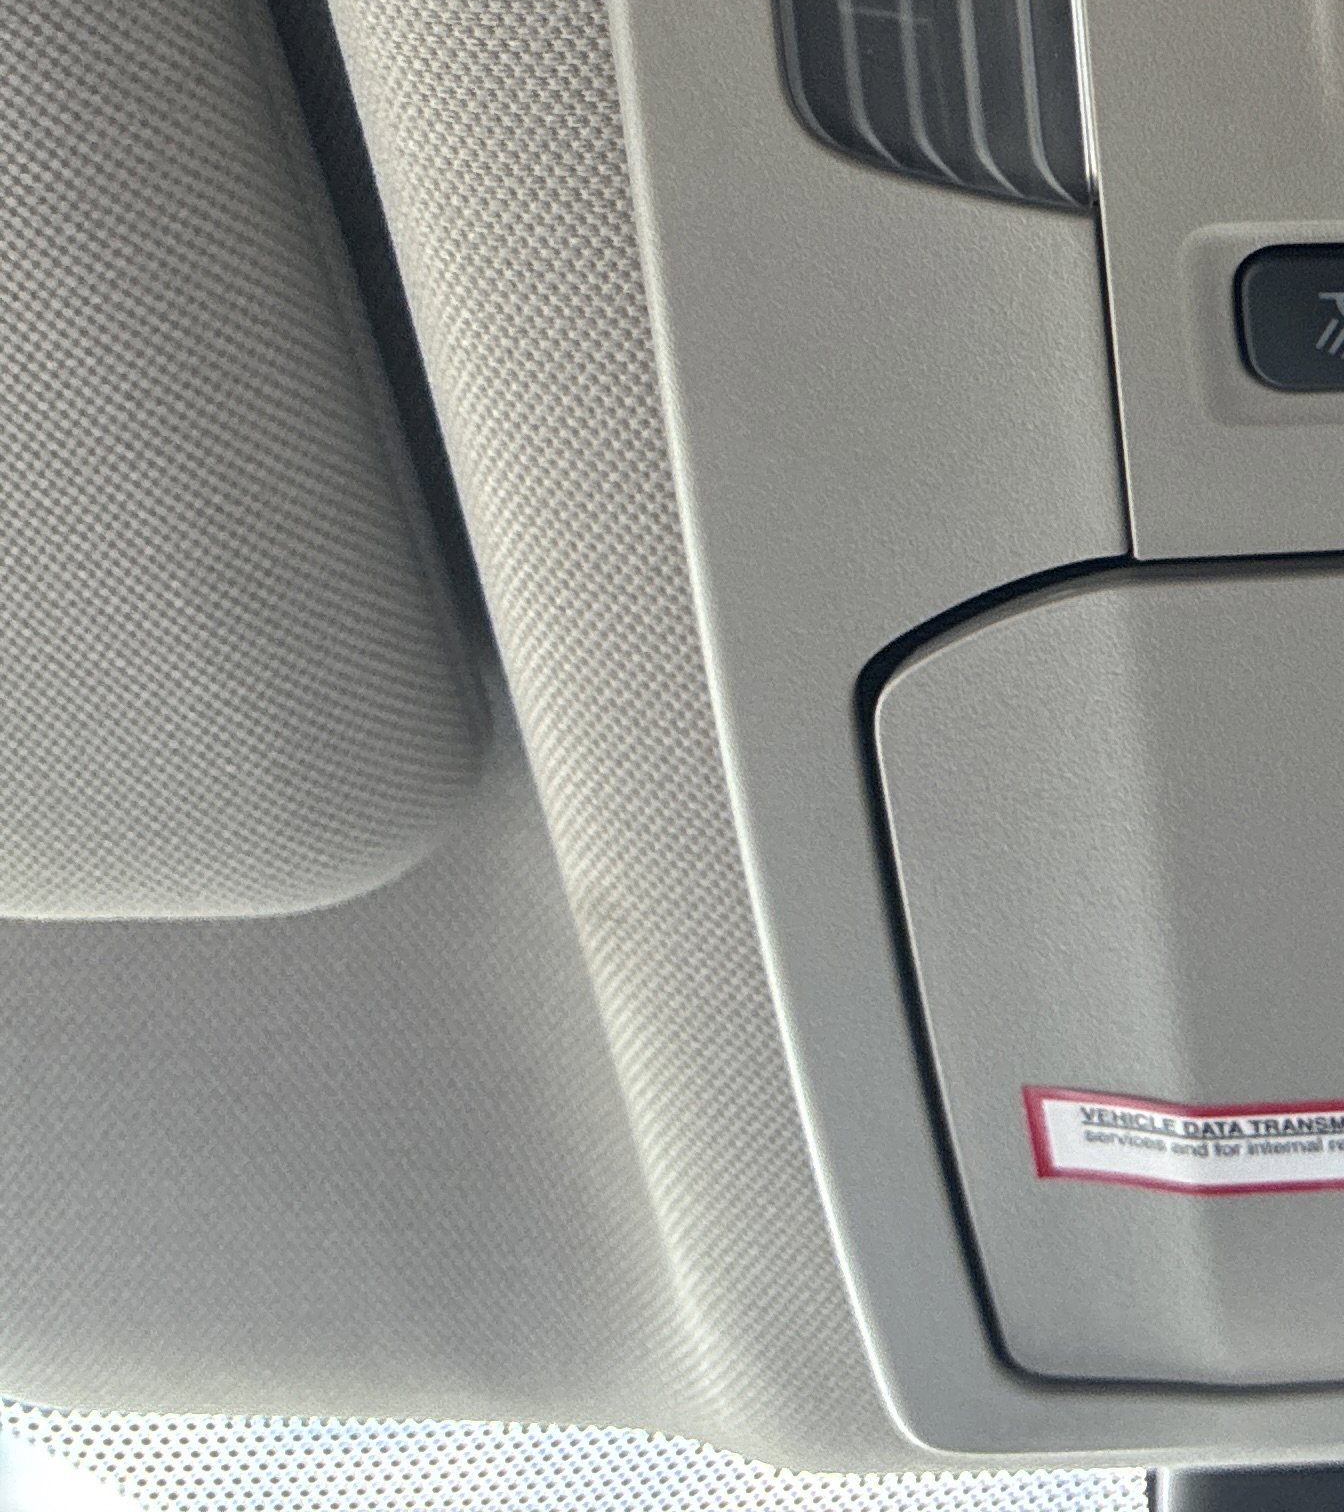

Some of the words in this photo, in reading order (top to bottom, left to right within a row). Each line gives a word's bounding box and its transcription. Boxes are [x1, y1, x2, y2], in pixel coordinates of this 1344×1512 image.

[1080, 1106, 1176, 1134] VEHICLE
[1184, 1120, 1243, 1137] DATA
[1082, 1129, 1167, 1152] services
[1170, 1140, 1209, 1157] and
[1214, 1141, 1242, 1157] for
[1249, 1137, 1323, 1156] internal
